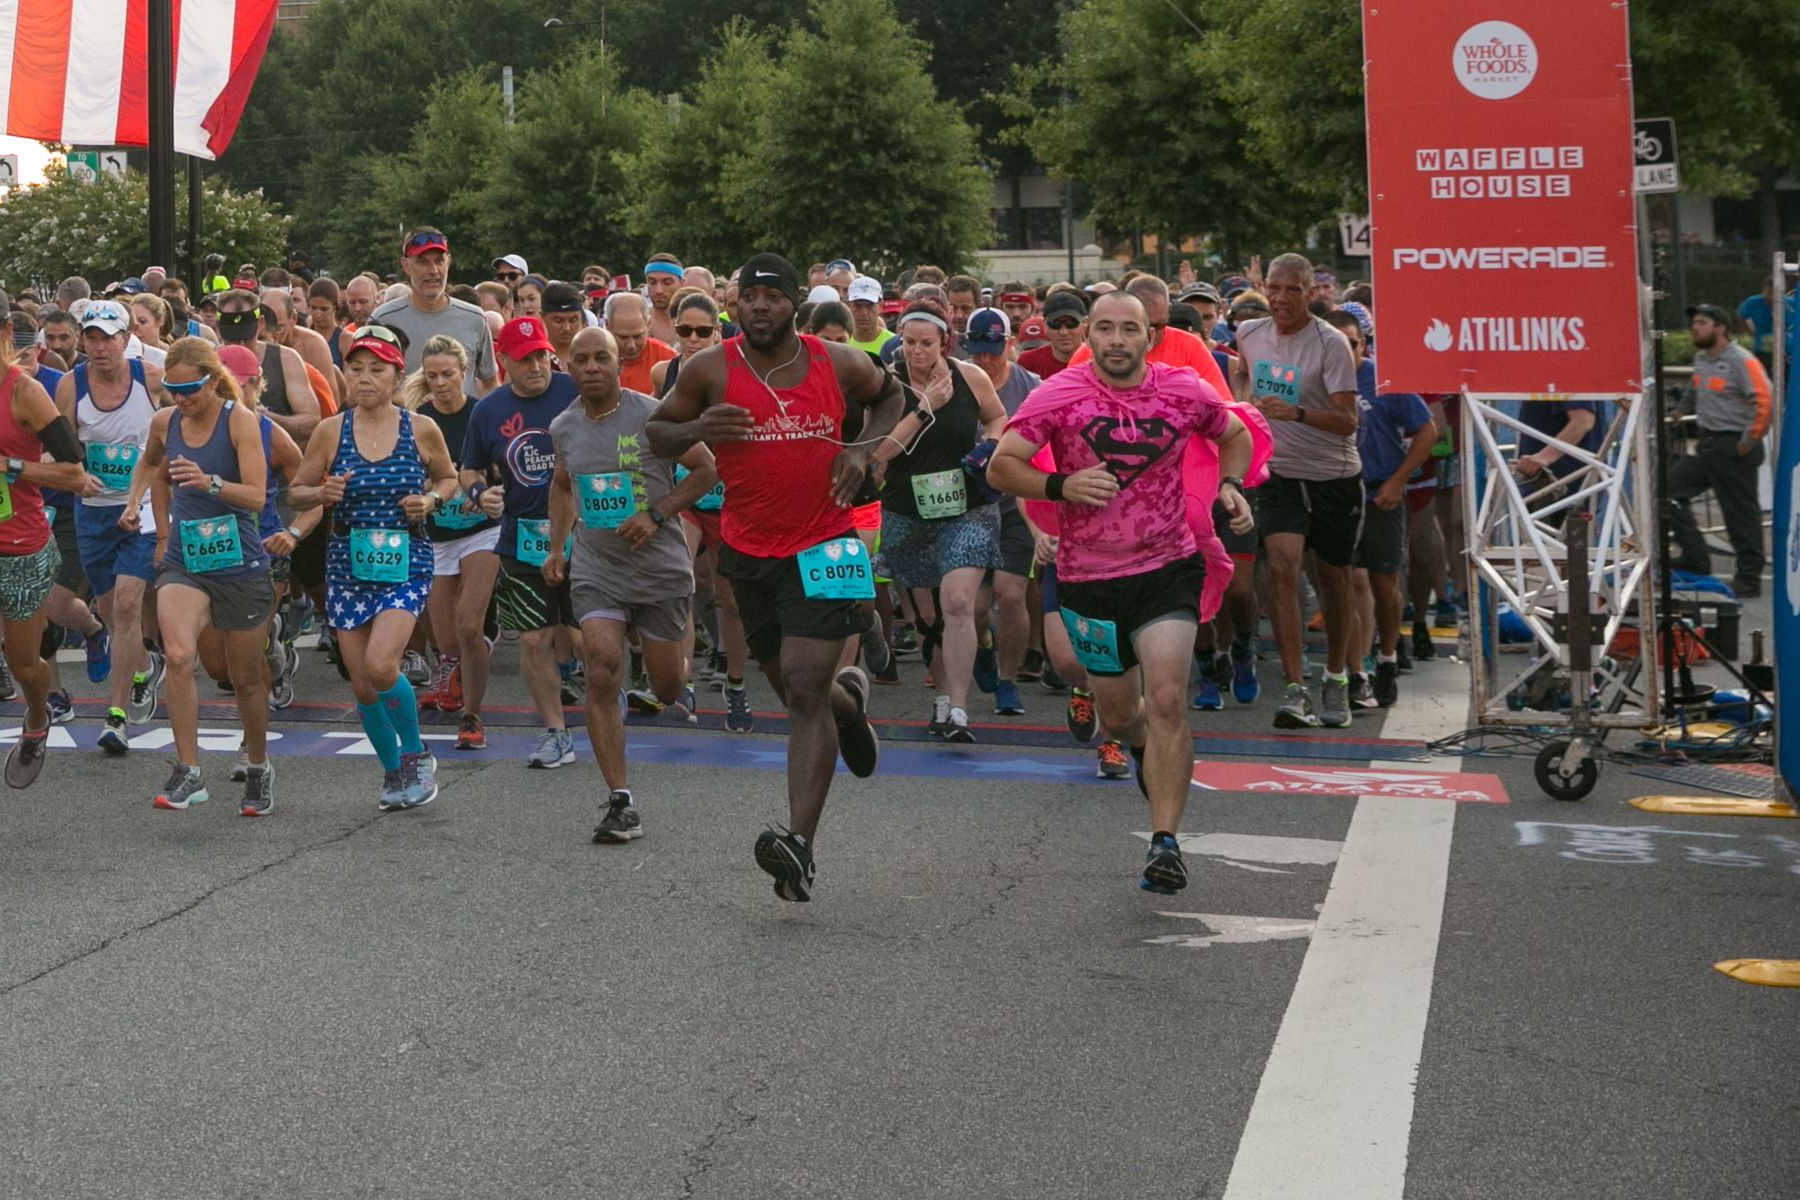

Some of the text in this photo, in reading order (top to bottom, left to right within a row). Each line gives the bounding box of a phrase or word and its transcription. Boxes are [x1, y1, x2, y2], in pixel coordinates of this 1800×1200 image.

[1462, 43, 1528, 59] WHOLE
[1466, 60, 1527, 75] FOODS
[1417, 148, 1583, 170] WAFFLE
[73, 169, 91, 181] 400
[1639, 168, 1673, 186] LANE
[1432, 177, 1569, 197] HOUSE
[1393, 246, 1606, 270] POWERADE
[1458, 317, 1585, 351] ATHLINKS
[1257, 379, 1294, 396] C 7076
[743, 432, 782, 441] ATLANTA
[785, 431, 813, 440] TRACK
[524, 449, 539, 457] AJC
[92, 462, 132, 475] C 8269
[526, 463, 547, 471] ROAD
[584, 496, 627, 511] C 8039
[917, 489, 966, 506] E 16605
[439, 506, 447, 517] C
[186, 538, 236, 557] C 6652
[523, 540, 532, 551] C
[355, 551, 402, 565] C 6329
[809, 565, 865, 582] C 8075
[1244, 780, 1491, 800] ATLANTA
